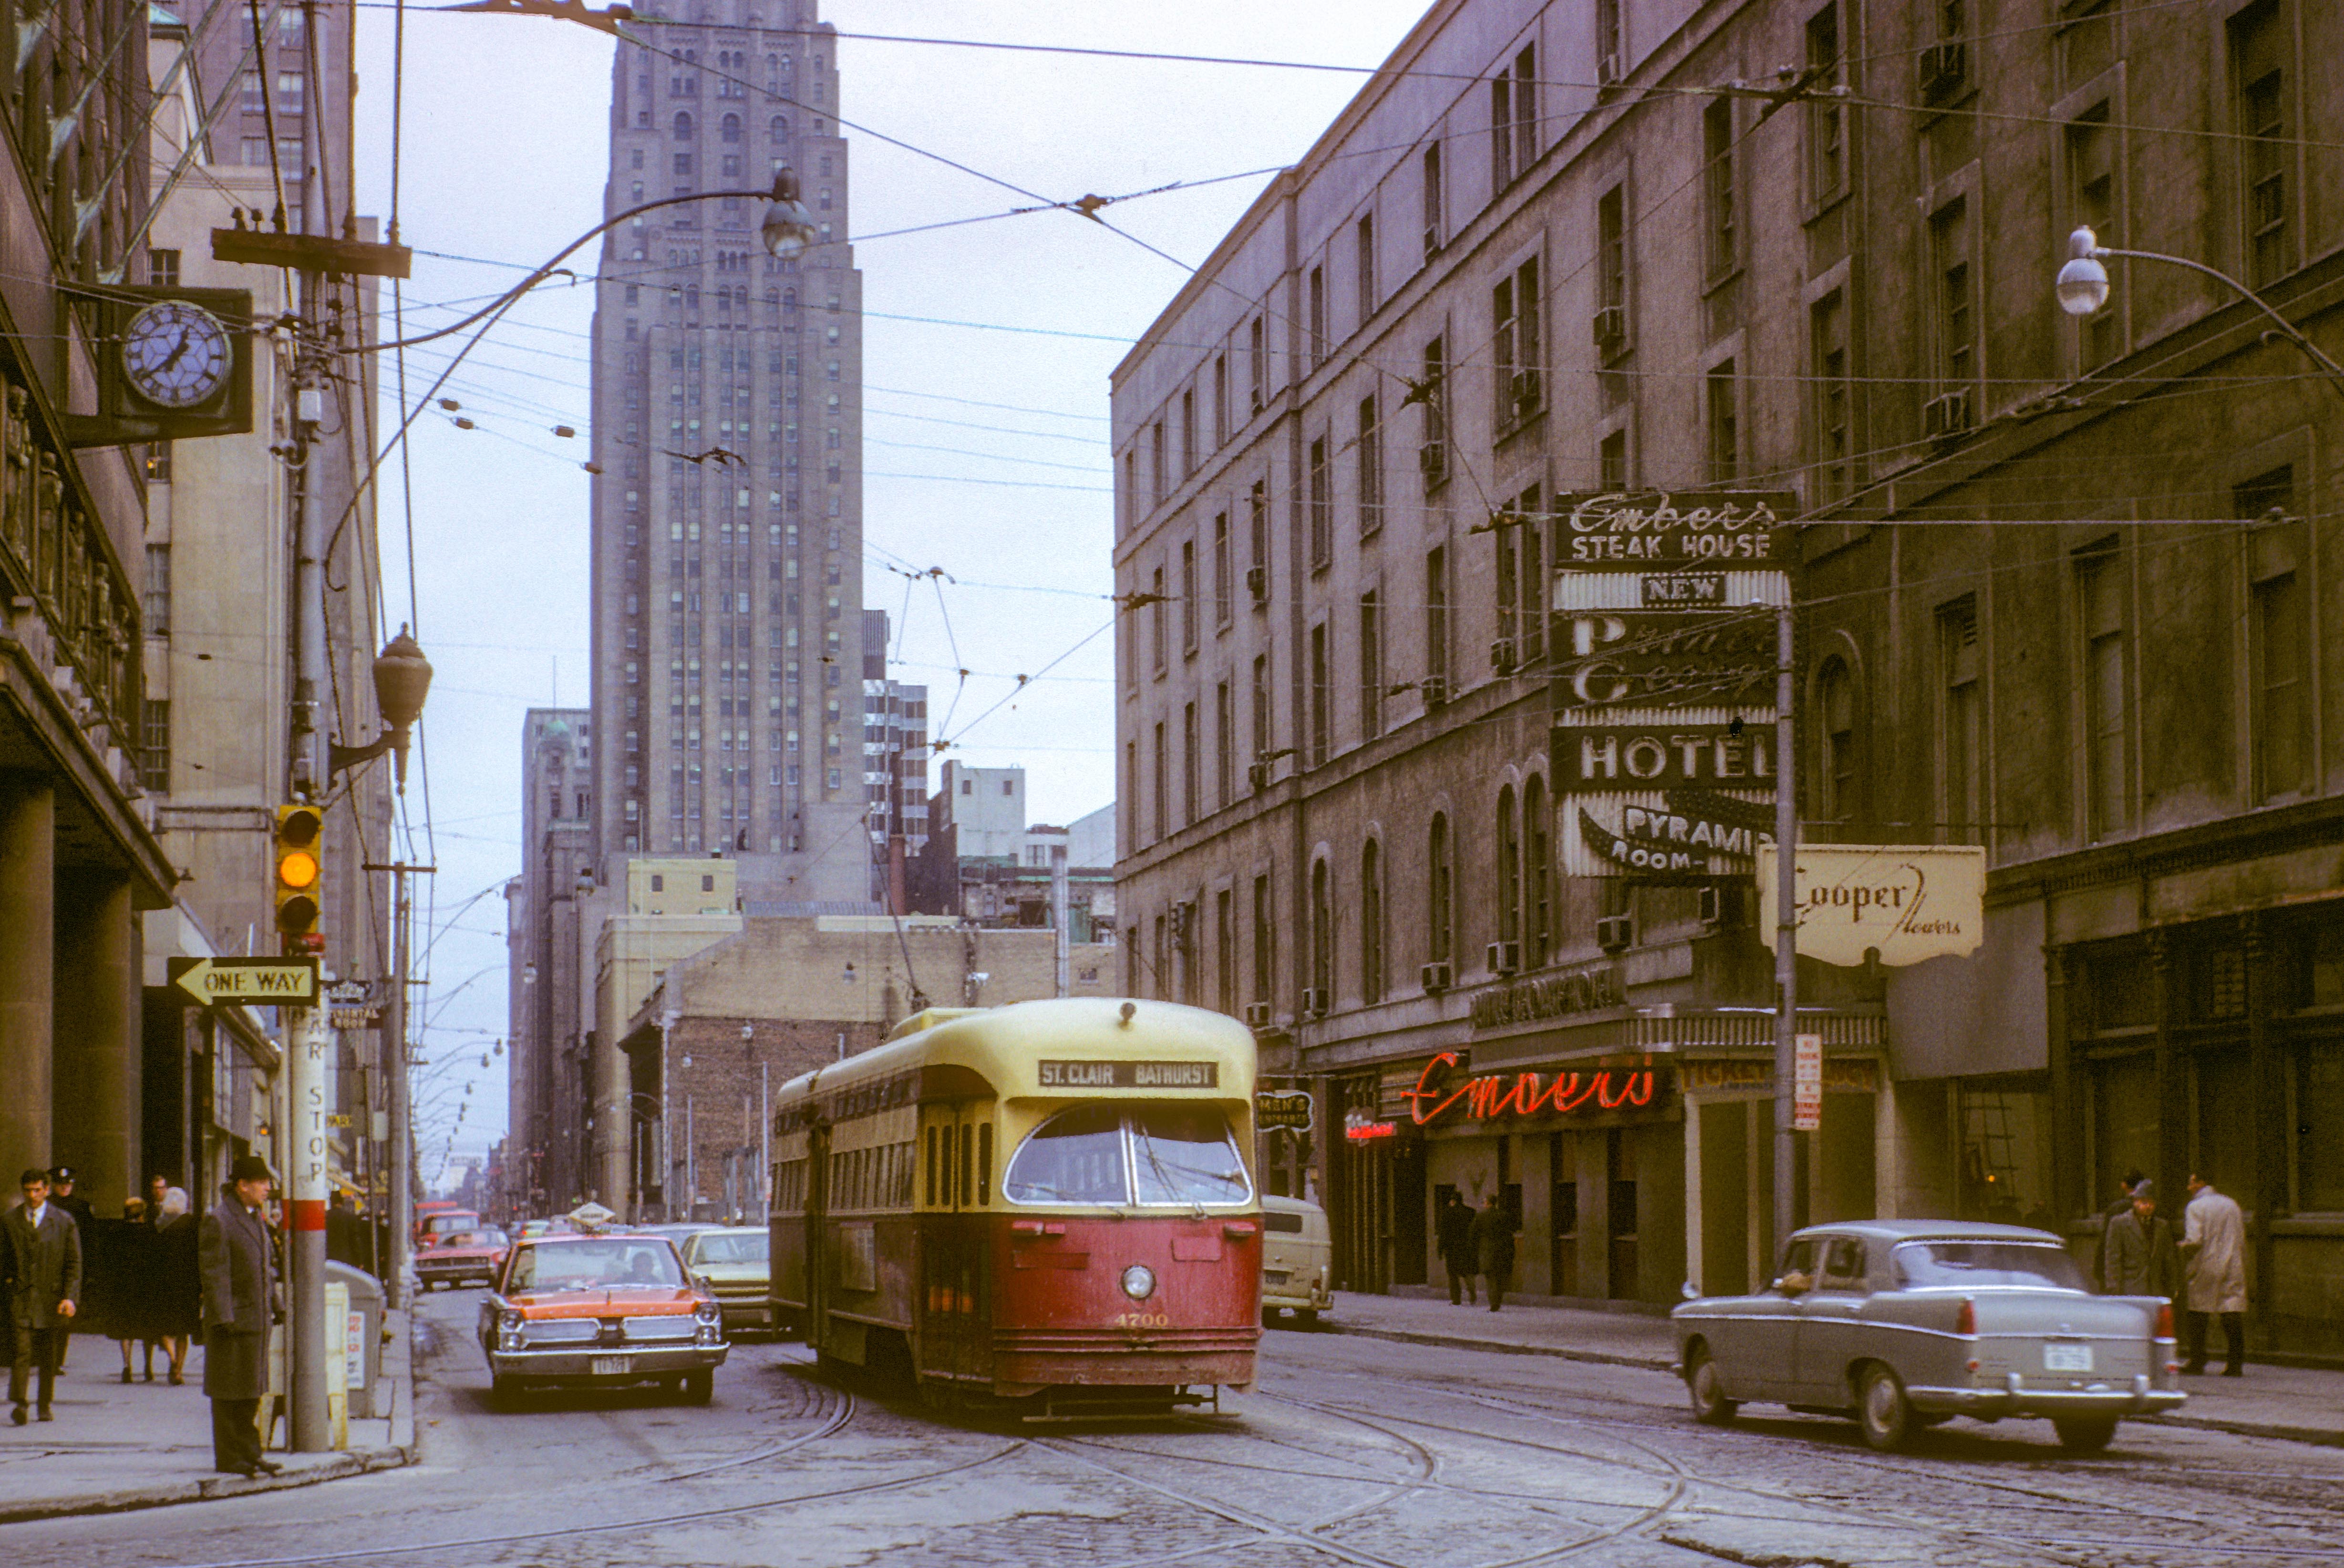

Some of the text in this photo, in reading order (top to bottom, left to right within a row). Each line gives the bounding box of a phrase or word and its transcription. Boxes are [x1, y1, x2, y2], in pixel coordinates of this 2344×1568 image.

[1572, 534, 1770, 558] STEAK HOUSE
[1648, 578, 1719, 600] NEW
[1581, 735, 1777, 779] HOTEL
[1796, 866, 1907, 923] ooper
[204, 972, 305, 993] ONE WAY
[1042, 1068, 1210, 1084] ST. CLAIR BATHURST
[310, 1086, 323, 1182] STOP
[1114, 1313, 1168, 1327] 4700
